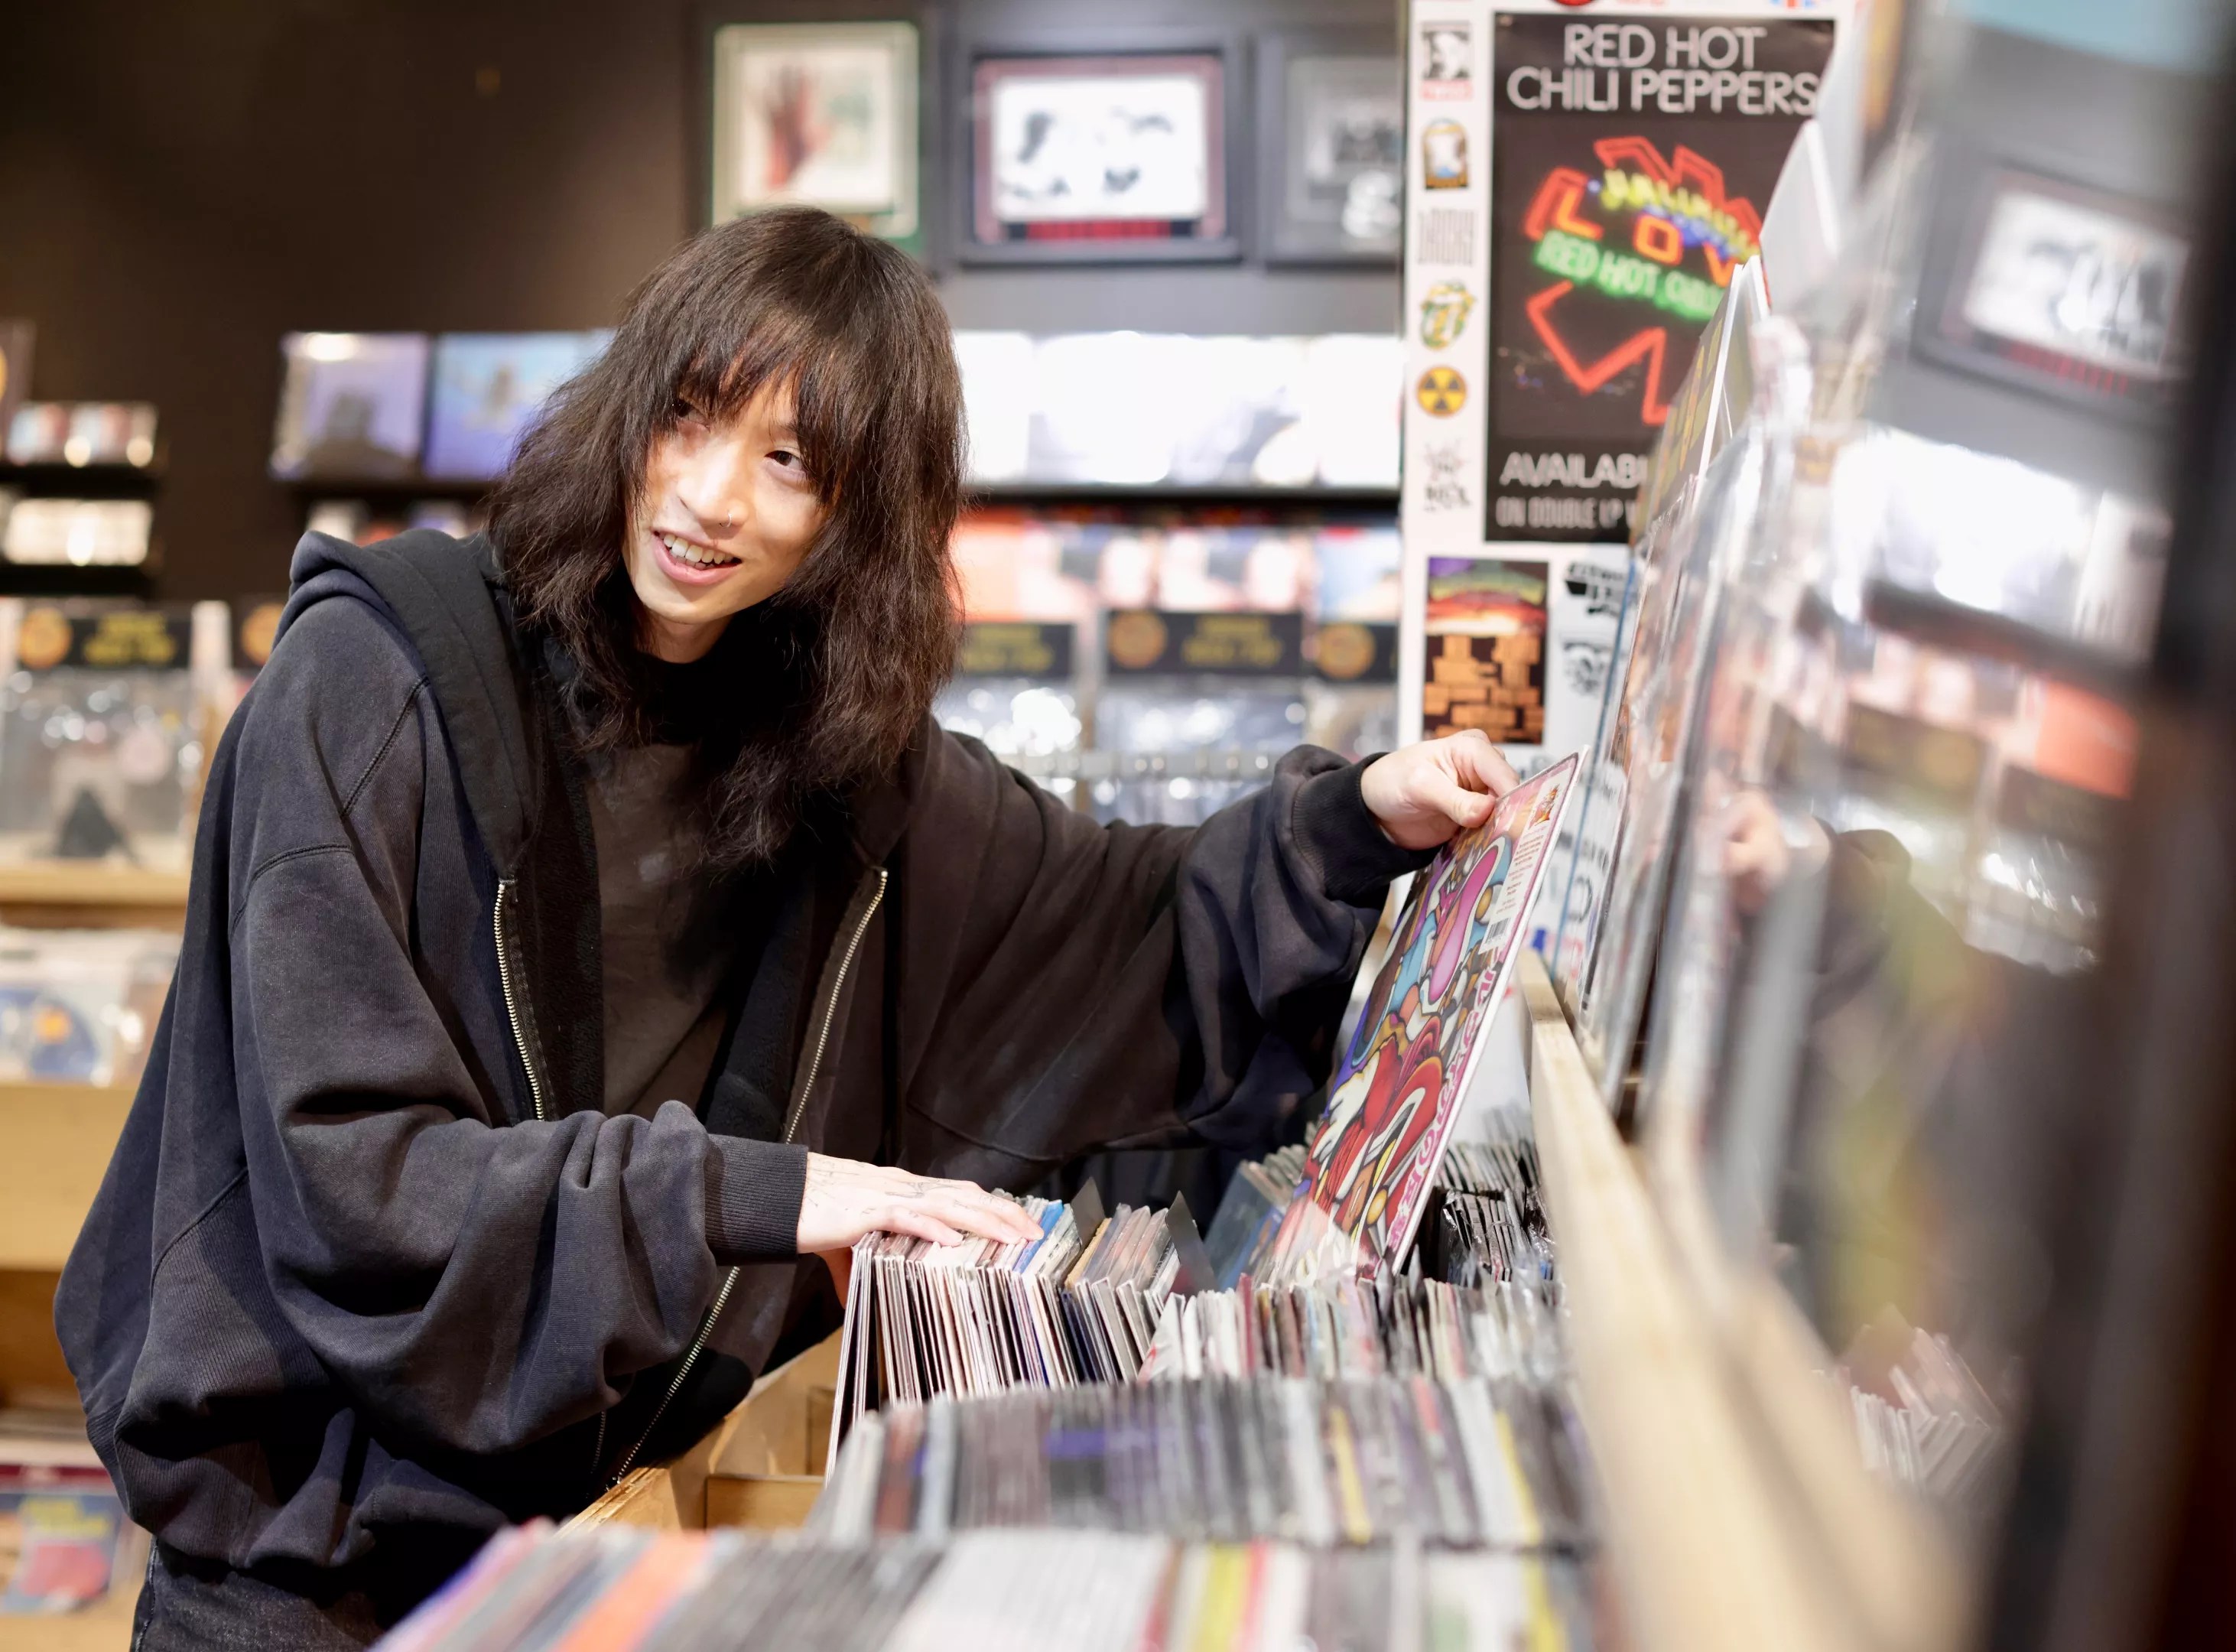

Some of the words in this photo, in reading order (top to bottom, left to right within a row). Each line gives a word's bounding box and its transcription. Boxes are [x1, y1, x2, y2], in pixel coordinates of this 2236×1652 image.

[1564, 24, 1656, 67] RED
[1666, 25, 1768, 70] HOT
[1506, 66, 1620, 111] CHILI
[1630, 69, 1821, 115] PEPPERS
[1598, 250, 1661, 299] HOT
